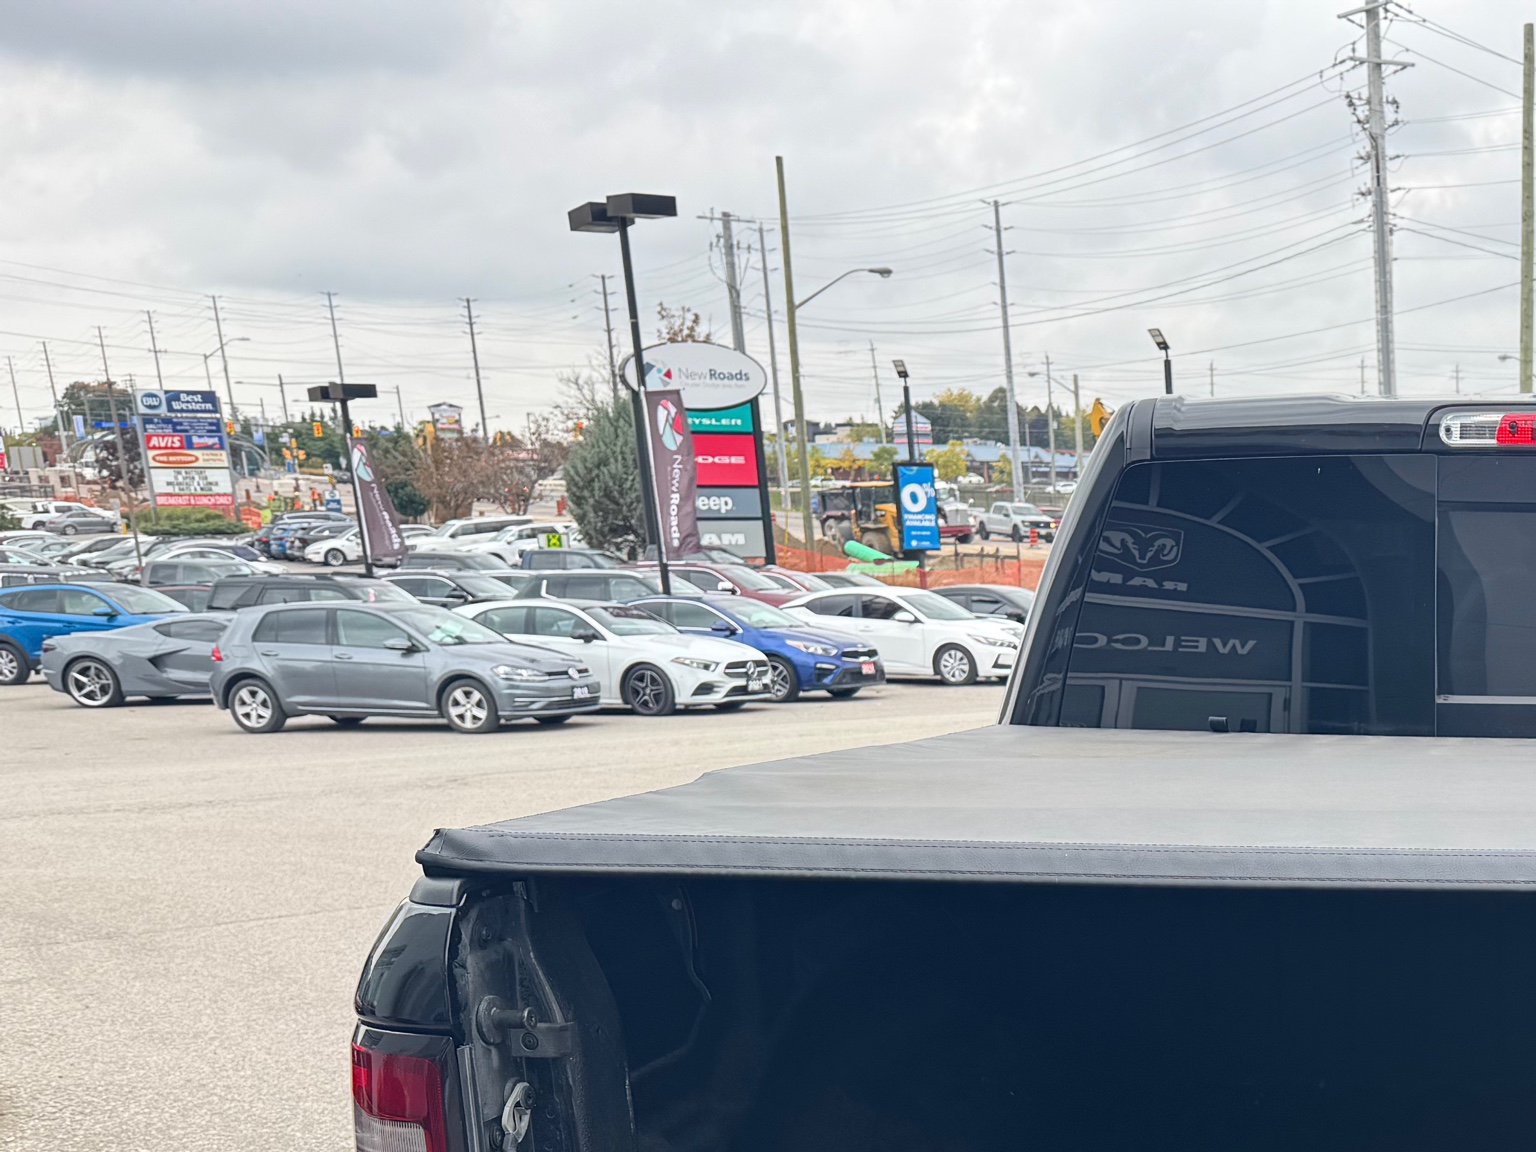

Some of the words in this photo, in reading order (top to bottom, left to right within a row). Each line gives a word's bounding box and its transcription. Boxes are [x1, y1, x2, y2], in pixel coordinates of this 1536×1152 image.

[678, 367, 751, 382] NewRoads
[142, 396, 160, 406] BW
[179, 392, 203, 402] Best
[171, 400, 213, 411] Western
[687, 417, 742, 426] RYSLER
[149, 436, 182, 448] AVIS
[695, 455, 746, 464] DGE
[670, 454, 683, 547] NewRoads
[696, 495, 733, 514] eep
[700, 533, 746, 545] AM
